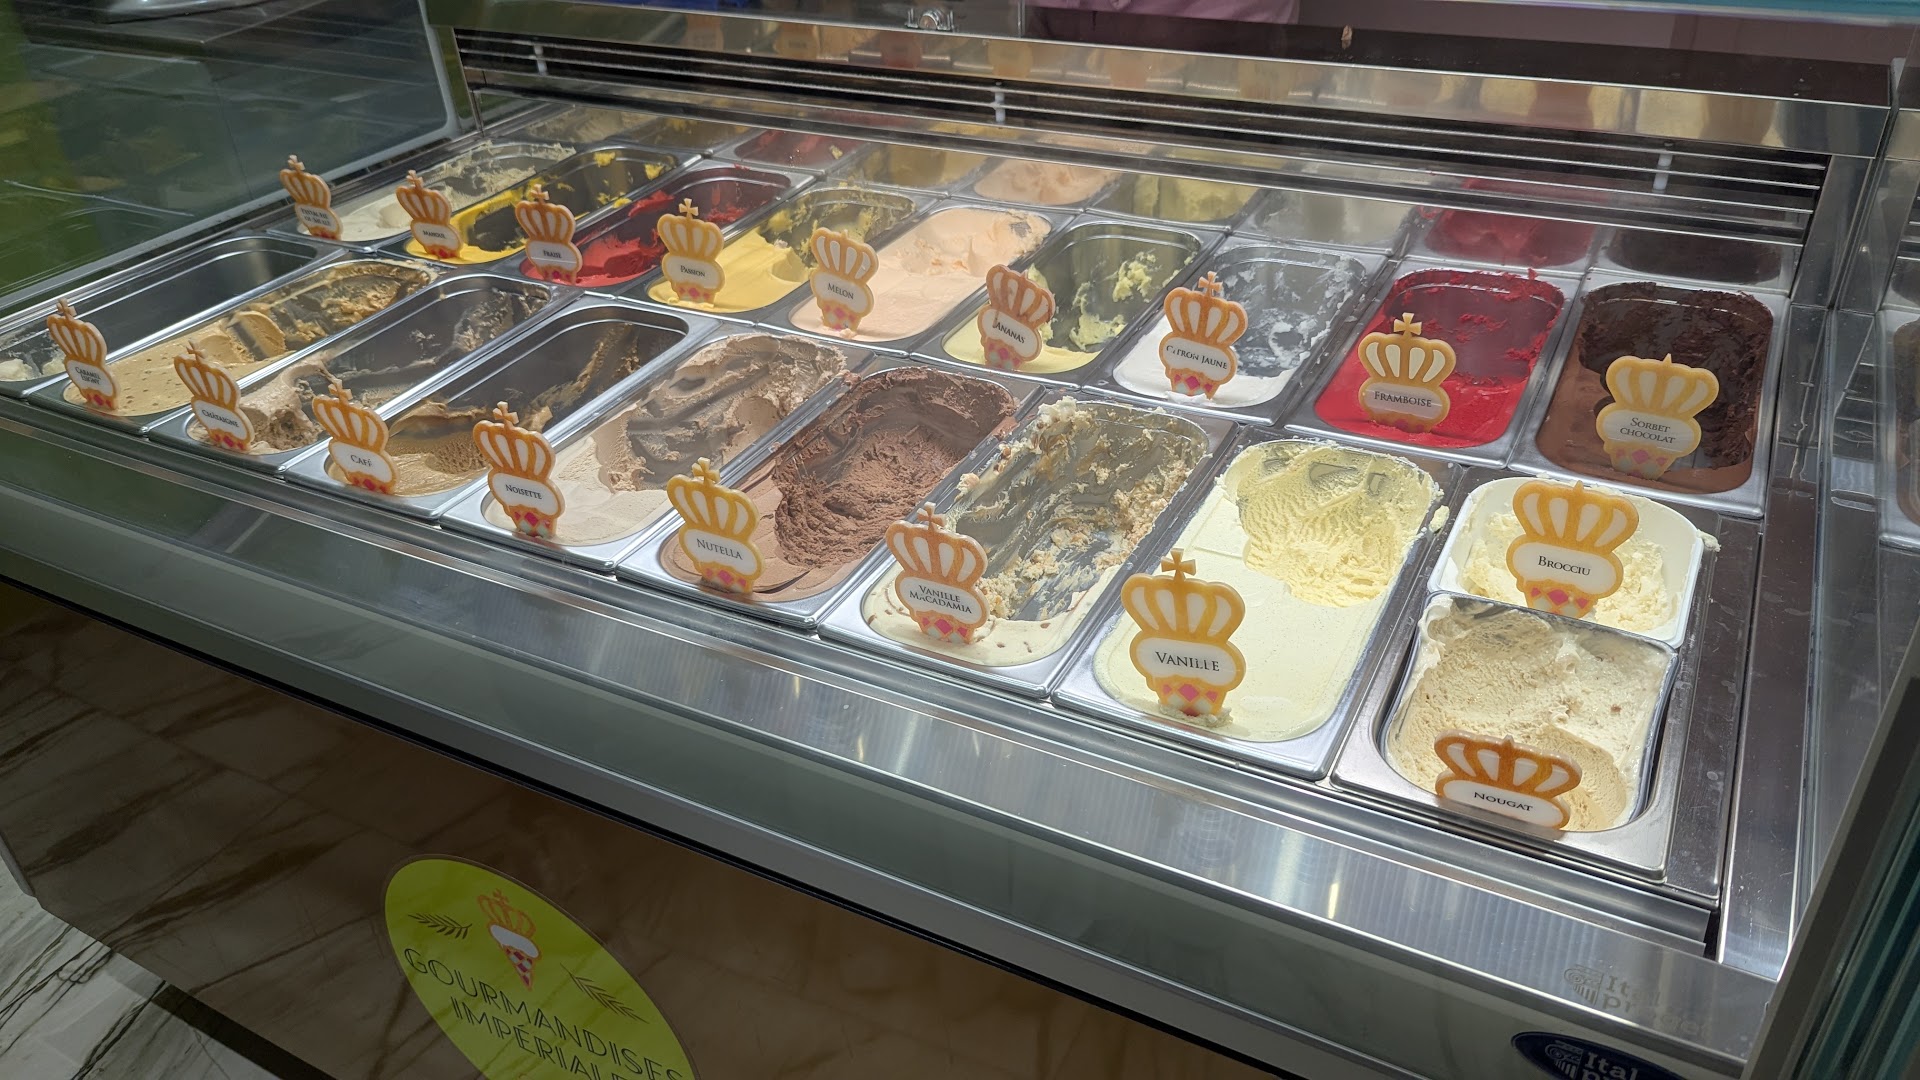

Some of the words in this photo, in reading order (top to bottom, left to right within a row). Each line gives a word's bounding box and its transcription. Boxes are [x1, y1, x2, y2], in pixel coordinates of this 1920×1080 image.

[680, 265, 706, 277] PASSION
[827, 282, 854, 300] MELON
[995, 321, 1026, 344] ANANAS
[1201, 355, 1228, 370] JAUNE
[1374, 391, 1432, 408] FRAMBOISE
[1630, 417, 1671, 433] SORBET
[1620, 427, 1676, 444] CHOCOLAT
[505, 484, 542, 500] NOISETTE
[696, 538, 743, 561] NUTELLA
[1537, 555, 1591, 576] BROCCIU
[909, 590, 972, 614] MACADAMIA
[918, 584, 961, 603] VANILLE
[1154, 651, 1220, 672] VANILLE
[1474, 791, 1533, 811] NOUGAT
[450, 996, 628, 1080] IMPÉRIAL
[1583, 1051, 1639, 1080] Ital
